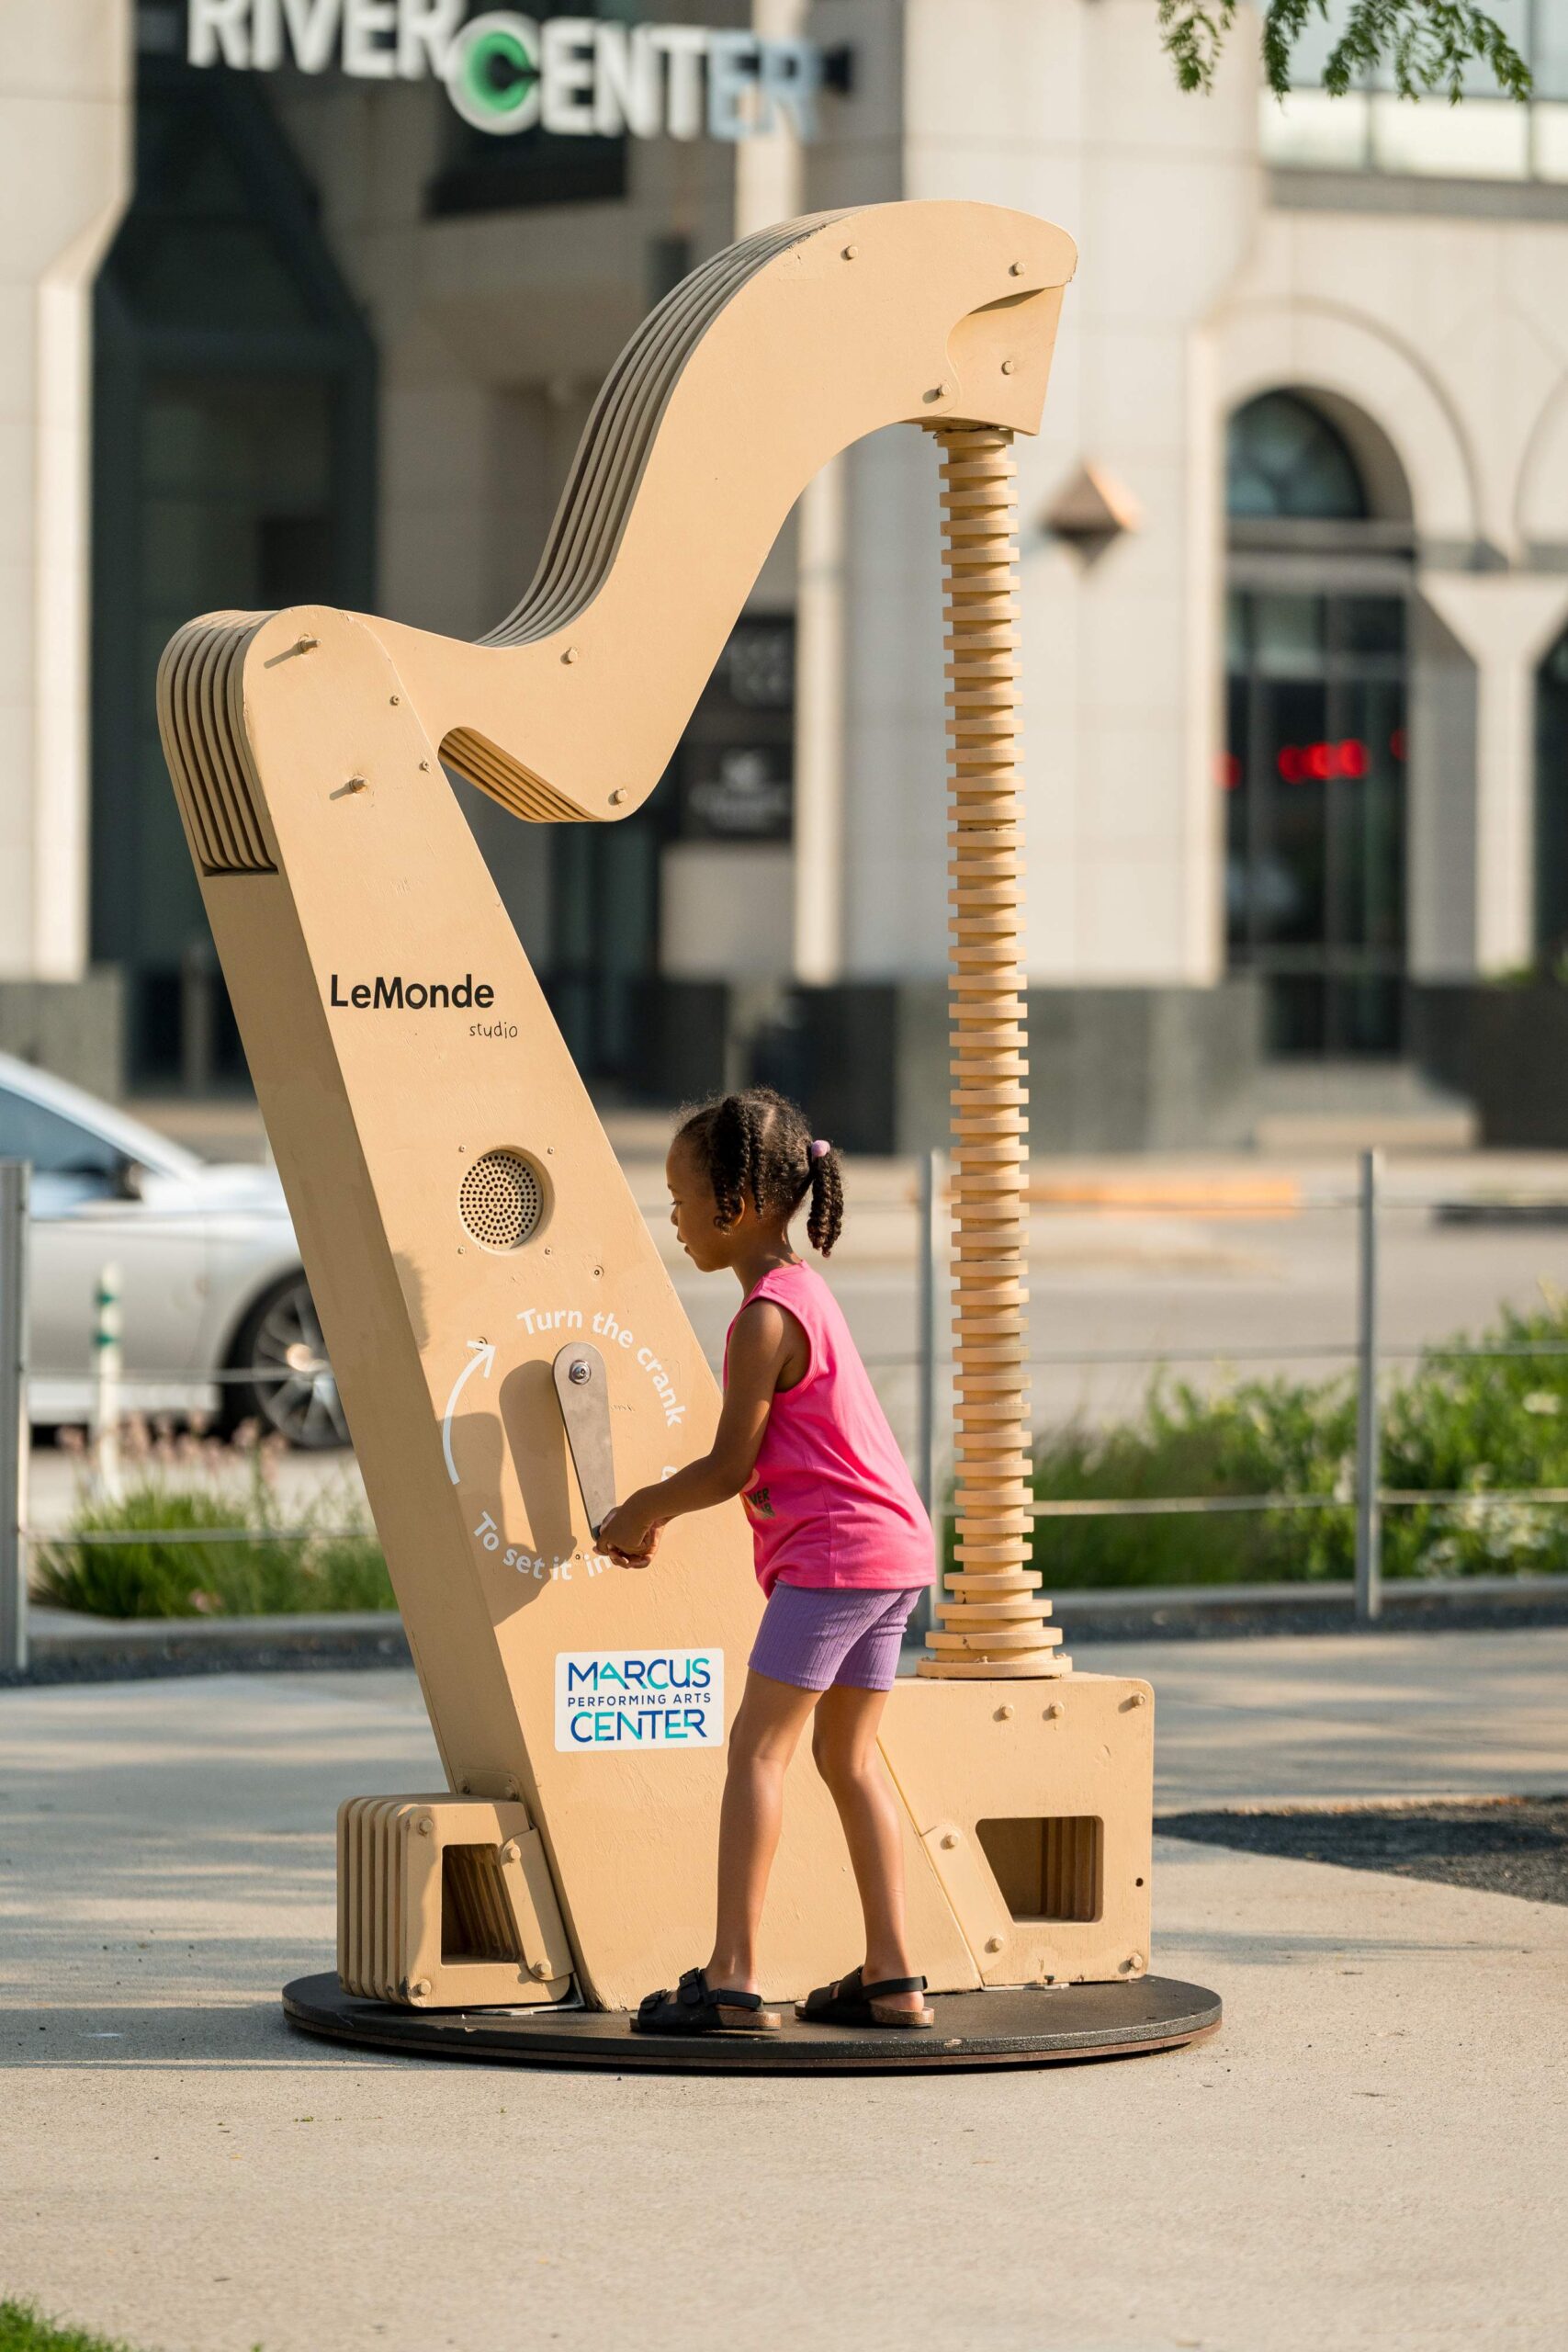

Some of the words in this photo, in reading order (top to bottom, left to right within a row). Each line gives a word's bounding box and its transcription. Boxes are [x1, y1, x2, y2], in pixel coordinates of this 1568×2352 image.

[330, 973, 495, 1010] LeMonde
[469, 1021, 518, 1039] studio
[516, 1307, 583, 1335] Turn
[592, 1311, 634, 1349] the
[637, 1347, 687, 1428] crank
[472, 1510, 500, 1551] To
[502, 1548, 546, 1579] set
[552, 1555, 573, 1581] it
[568, 1657, 711, 1692] MARCUS
[568, 1694, 667, 1708] PERFORMING
[672, 1692, 711, 1704] ARTS
[570, 1708, 708, 1744] CENTER
